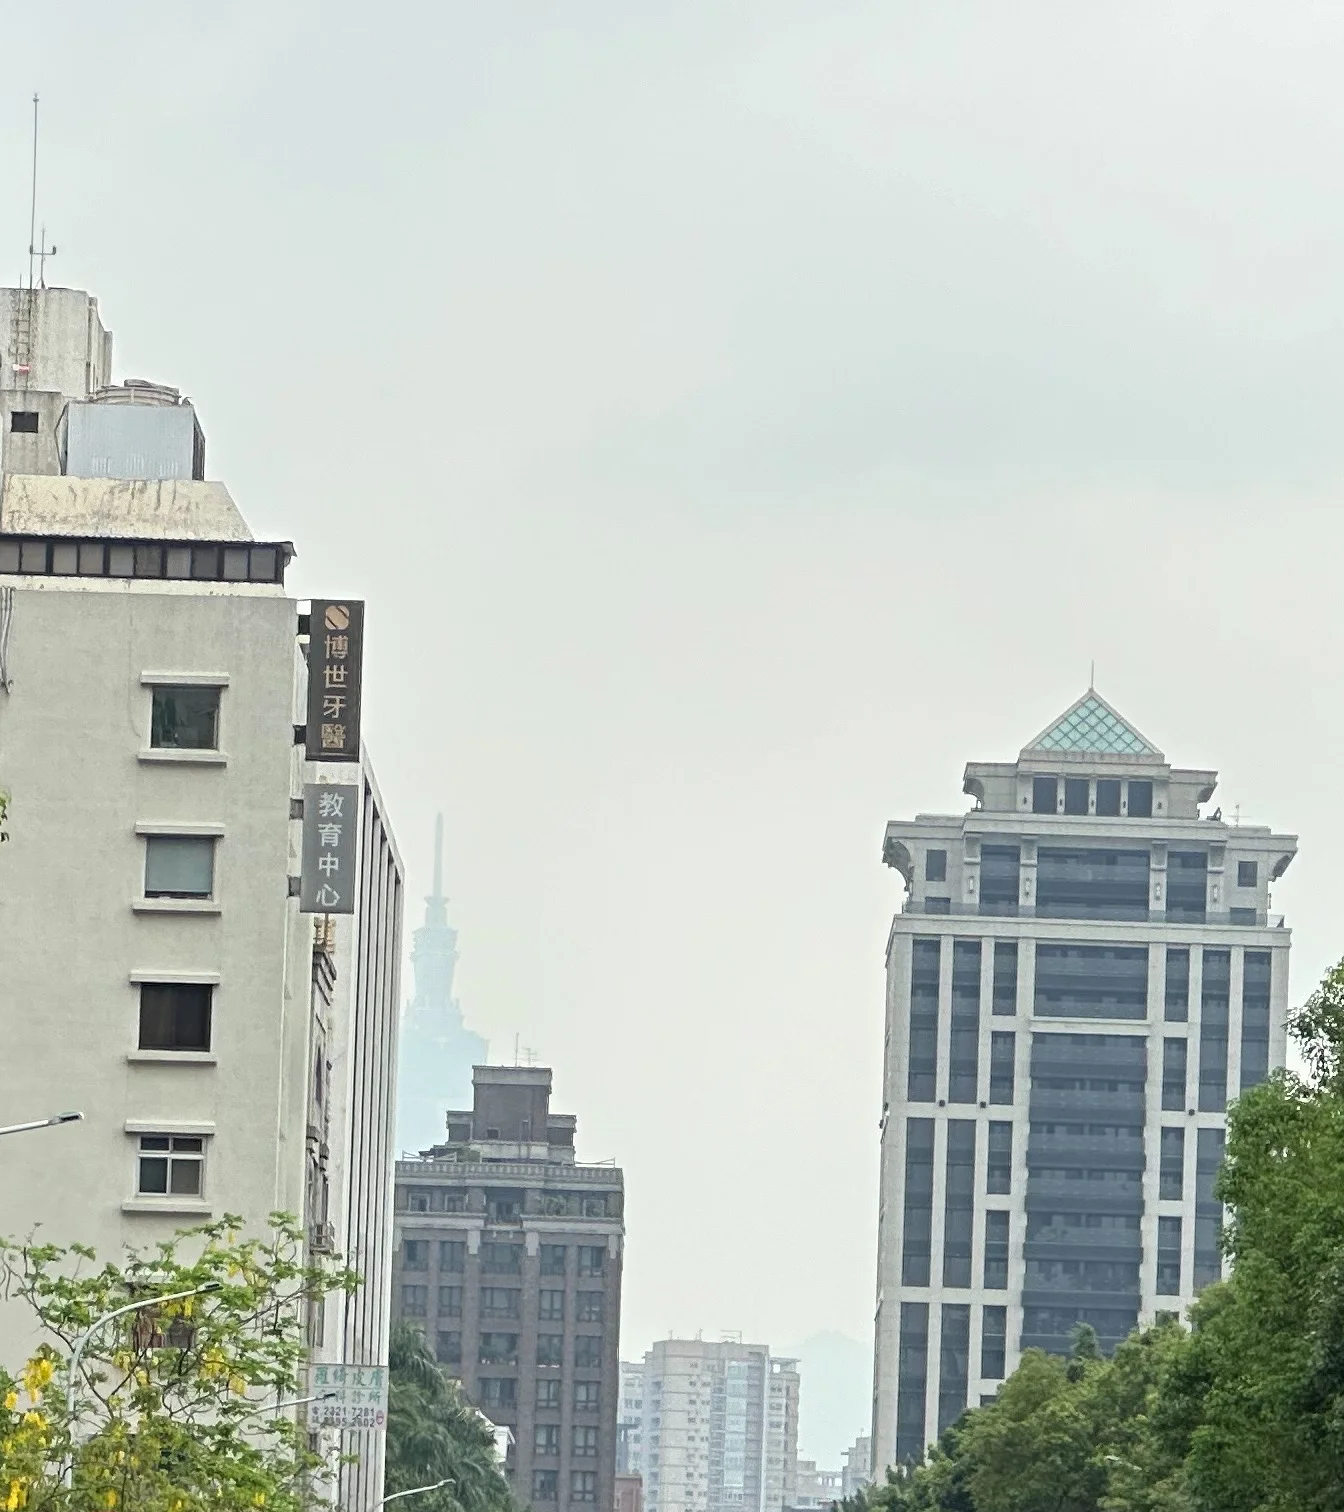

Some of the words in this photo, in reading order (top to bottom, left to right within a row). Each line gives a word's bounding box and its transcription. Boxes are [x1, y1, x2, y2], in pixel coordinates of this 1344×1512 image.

[320, 634, 349, 749] 博世牙醫
[316, 792, 345, 908] 教育中心
[319, 1389, 382, 1405] 科診所
